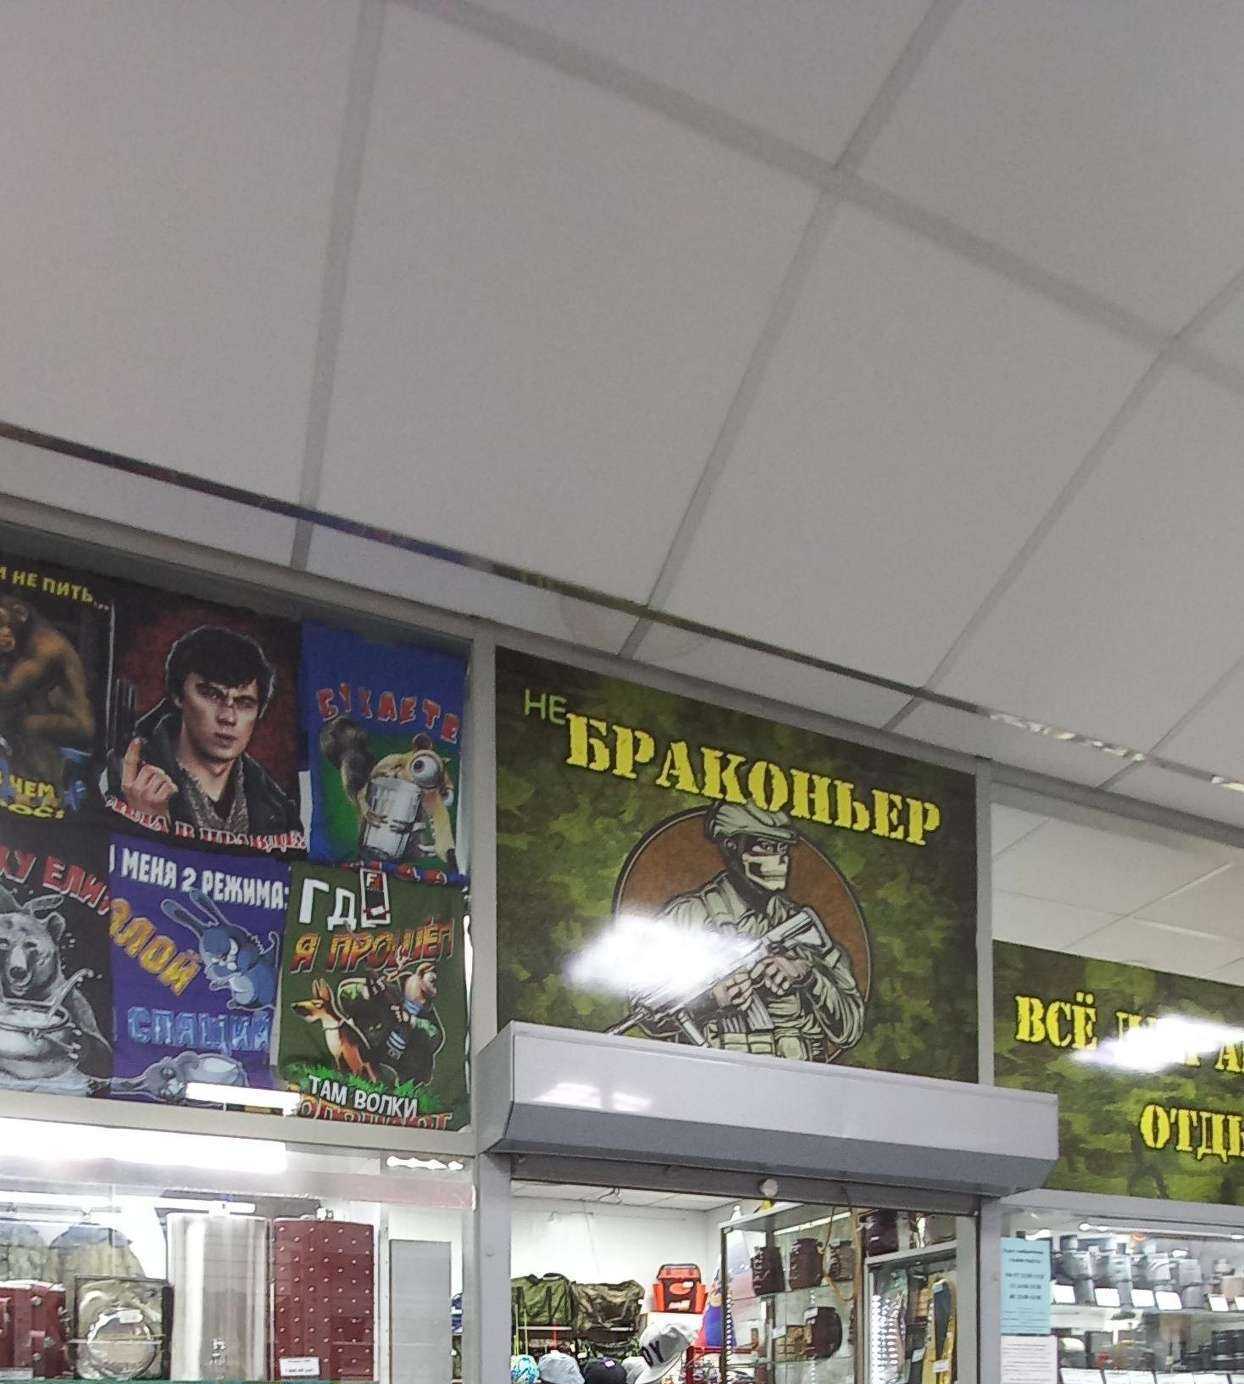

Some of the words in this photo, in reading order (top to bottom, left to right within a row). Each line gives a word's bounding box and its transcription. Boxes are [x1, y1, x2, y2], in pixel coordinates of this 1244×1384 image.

[13, 570, 38, 588] НЕ
[524, 689, 566, 725] НЕ
[566, 713, 941, 846] БРАКОНЬЕР
[121, 847, 178, 890] МЕНЯ
[181, 866, 198, 892] 2
[290, 931, 322, 974] Я
[1015, 991, 1098, 1049] ВСЁ
[308, 1074, 347, 1105] ТАМ
[354, 1089, 419, 1124] ВОЛКИ
